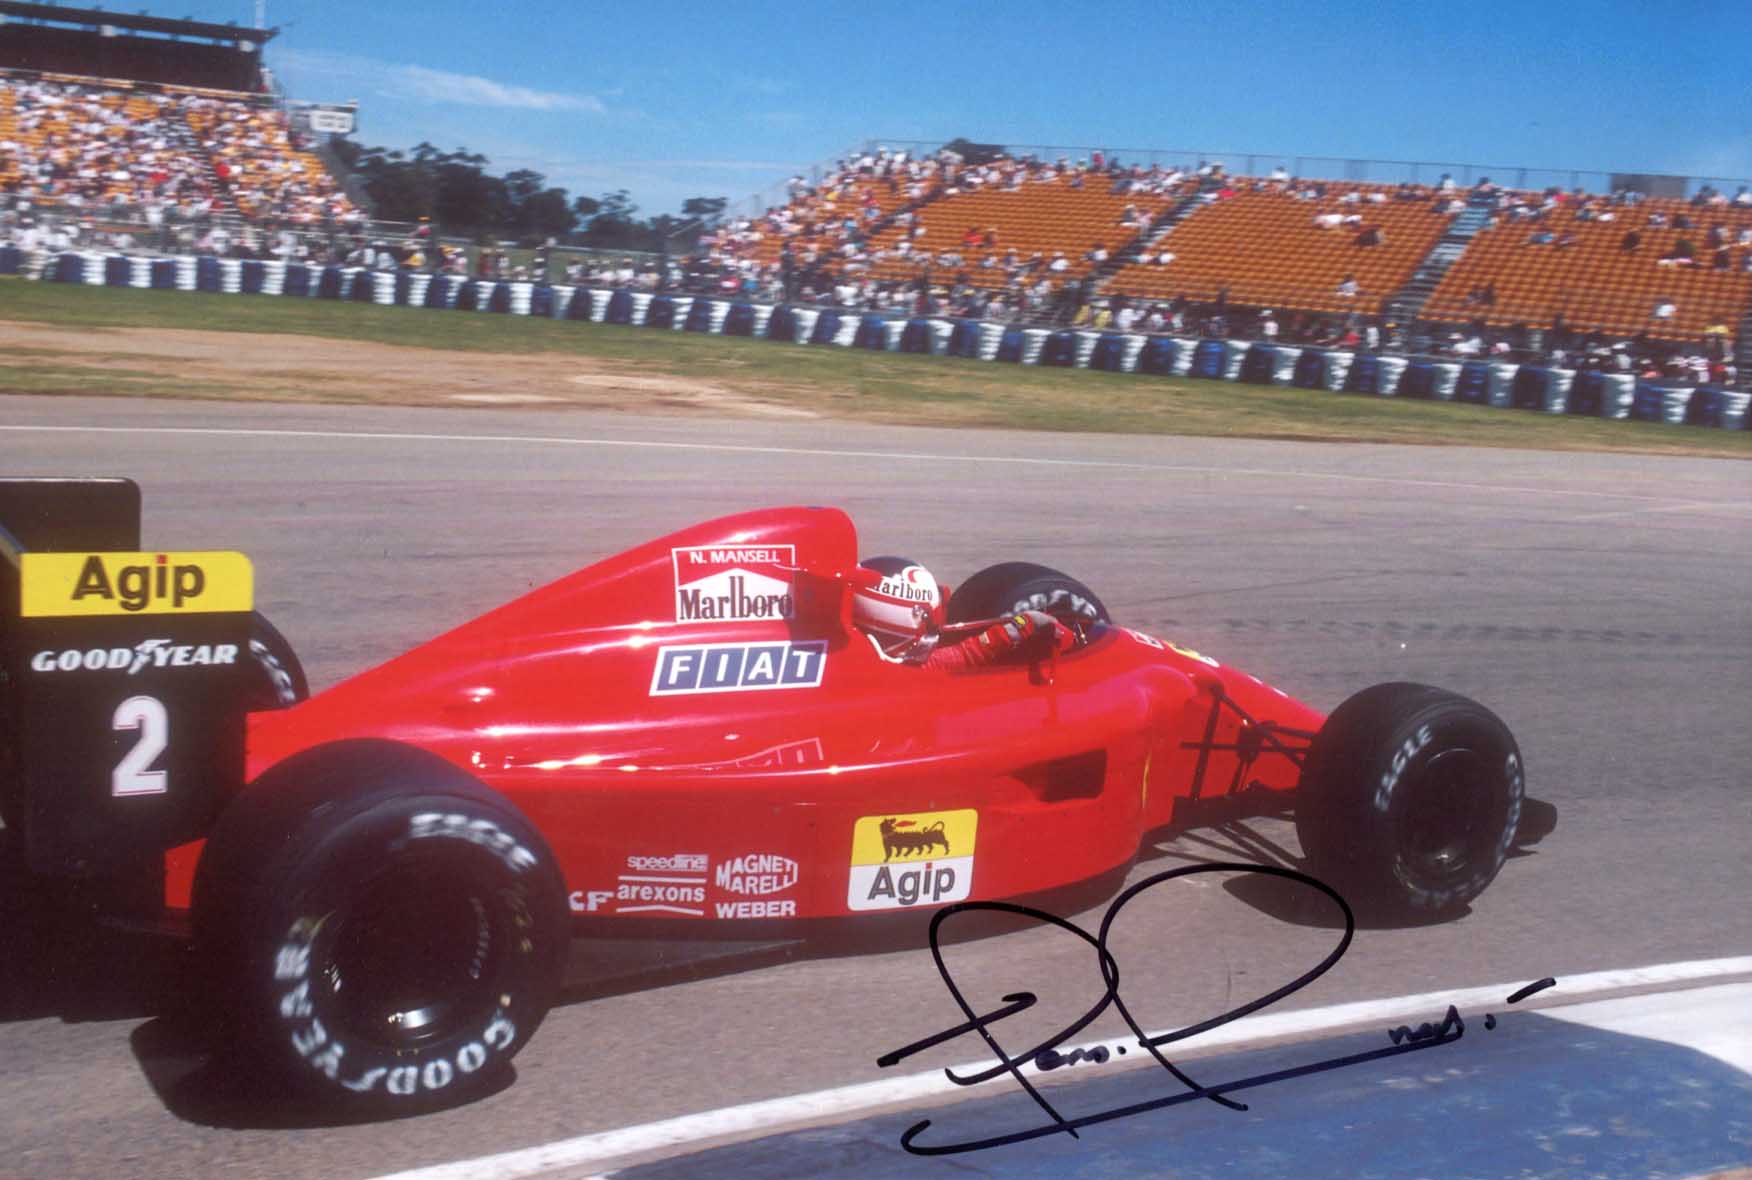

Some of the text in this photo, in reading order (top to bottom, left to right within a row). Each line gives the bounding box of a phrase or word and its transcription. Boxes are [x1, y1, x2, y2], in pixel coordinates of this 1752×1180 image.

[690, 549, 781, 563] N. MANSELL
[70, 555, 206, 612] Agip
[678, 575, 793, 620] Marlboro
[31, 639, 239, 675] GOODYEAR
[667, 651, 814, 685] FIAT
[111, 695, 169, 796] 2
[617, 884, 705, 902] arexons
[867, 862, 956, 906] Agip
[715, 900, 796, 919] WEBER
